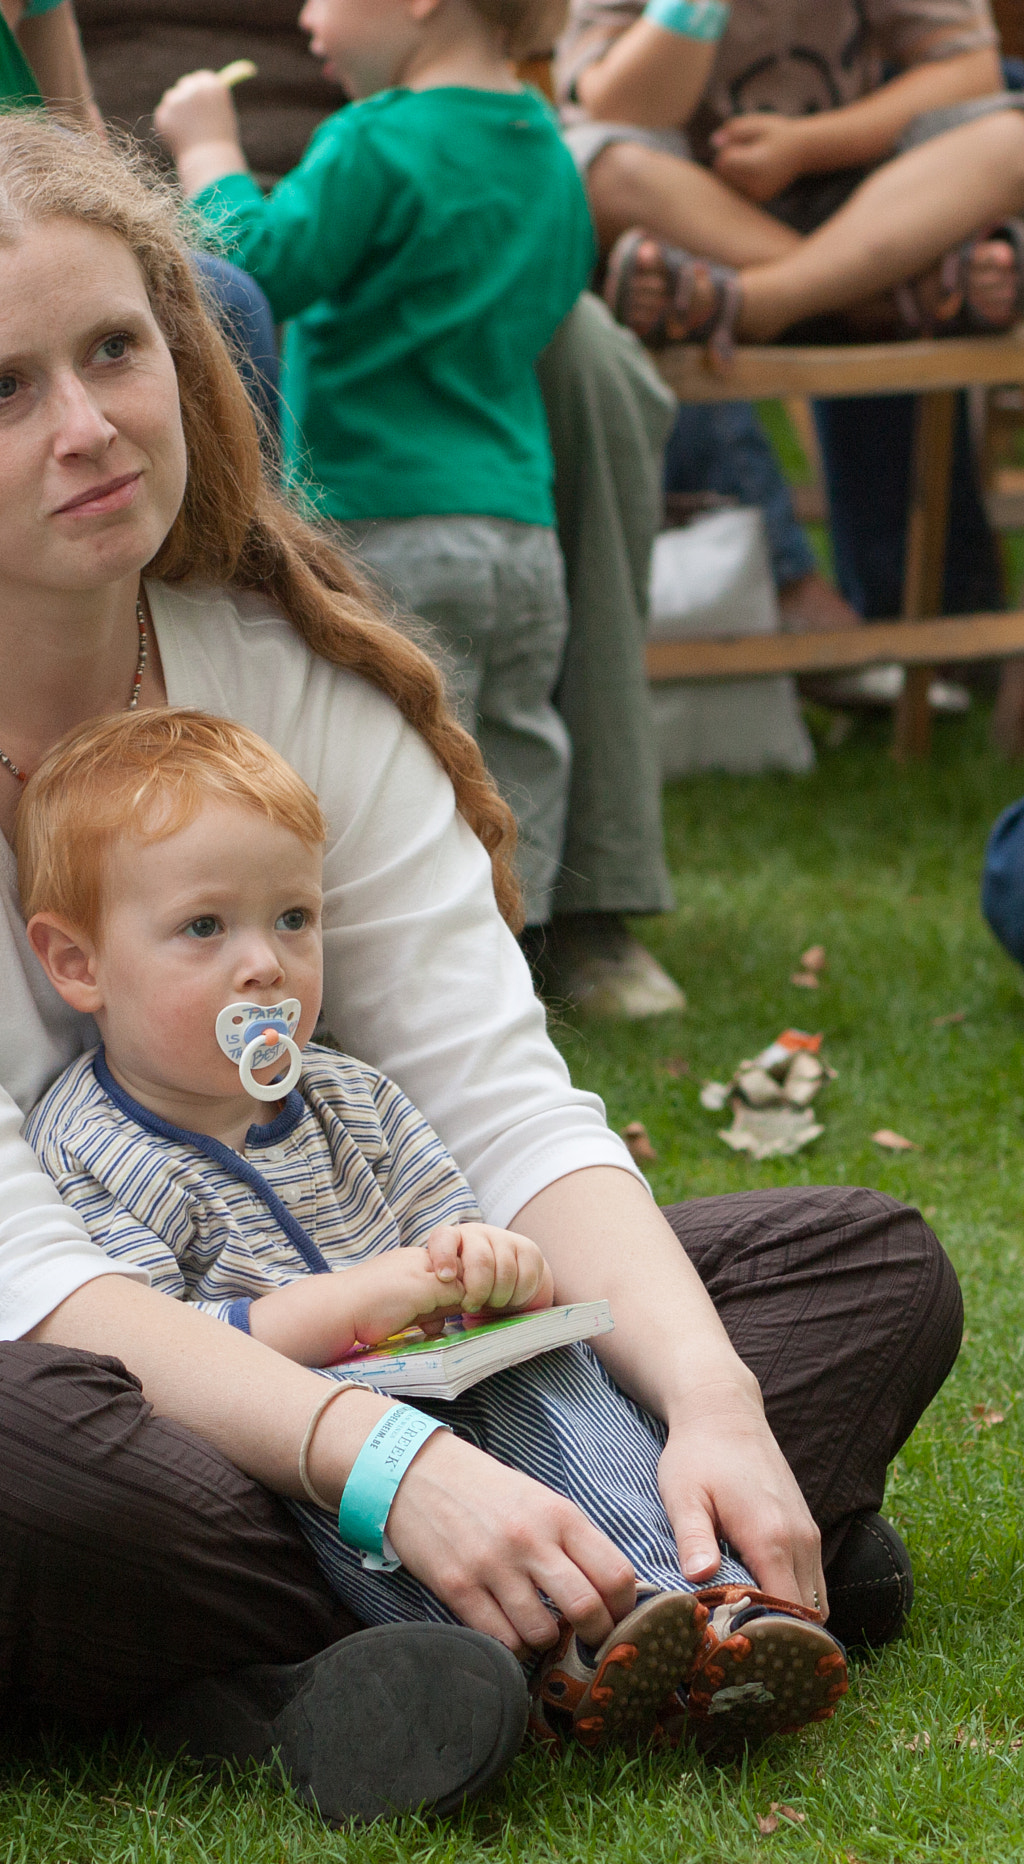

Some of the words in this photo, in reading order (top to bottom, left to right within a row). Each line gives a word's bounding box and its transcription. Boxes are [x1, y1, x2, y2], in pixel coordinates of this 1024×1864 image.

[242, 1007, 283, 1020] PAPA
[226, 1034, 240, 1044] IS
[228, 1047, 243, 1060] TH
